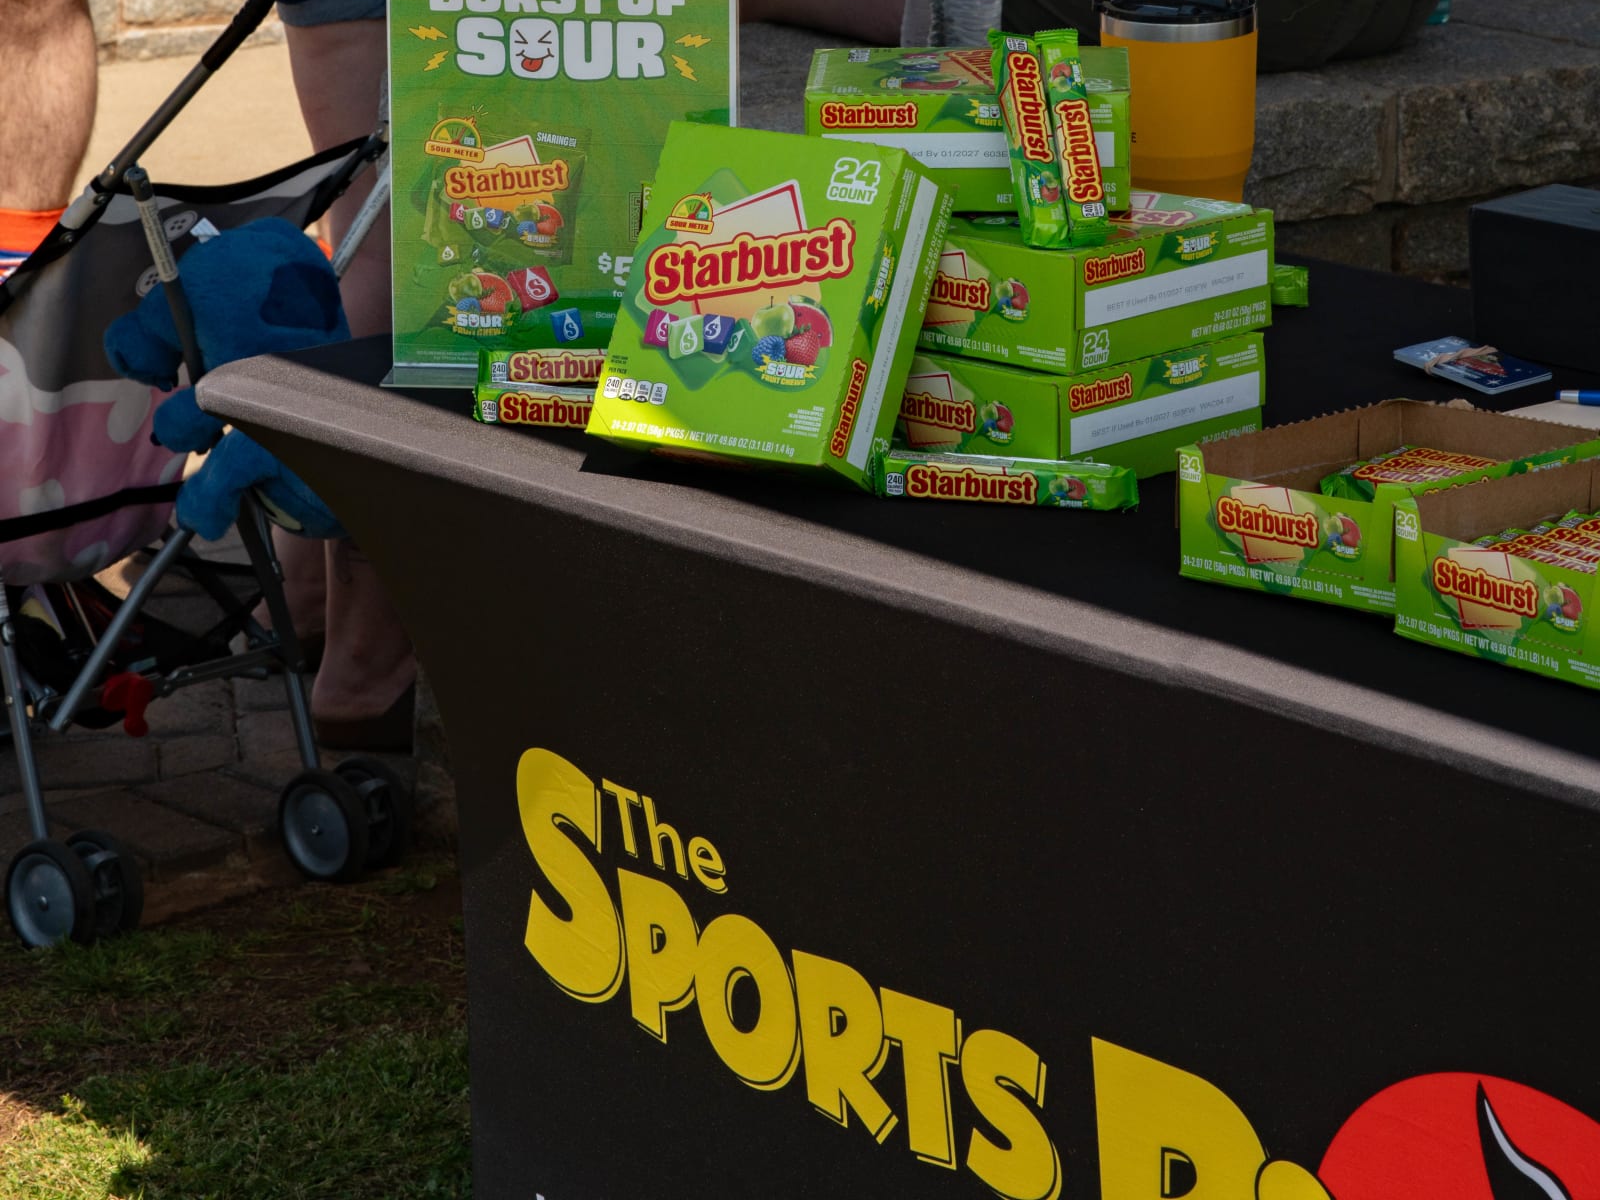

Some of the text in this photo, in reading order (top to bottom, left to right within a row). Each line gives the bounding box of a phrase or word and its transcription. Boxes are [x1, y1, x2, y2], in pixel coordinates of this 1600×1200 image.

[456, 16, 665, 79] SOUR
[823, 103, 915, 127] Starburst
[978, 104, 1001, 119] SO
[1012, 55, 1052, 162] Starburst
[536, 131, 570, 146] SHARING
[1062, 101, 1101, 201] Starburst
[926, 150, 938, 159] By
[983, 150, 1009, 159] 603E
[449, 163, 564, 195] Starburst
[832, 158, 880, 188] 24
[829, 184, 878, 204] COUNT
[1181, 233, 1212, 253] SOUR
[650, 226, 847, 295] Starburst
[1086, 249, 1145, 283] Starburst
[871, 256, 892, 300] SOUR
[930, 274, 988, 307] rburst
[456, 314, 502, 328] SOUR
[922, 330, 936, 342] NET
[935, 332, 947, 344] WT
[1083, 329, 1110, 354] 24
[491, 363, 507, 374] 240
[513, 355, 605, 381] Starbur
[766, 361, 806, 380] SOUR
[1083, 351, 1109, 368] COUNT
[1168, 357, 1201, 378] SOUR
[606, 377, 620, 389] 240
[761, 373, 781, 385] FRUIT
[1070, 374, 1131, 411] Starburst
[482, 401, 496, 413] 240
[503, 396, 594, 426] Starbur
[831, 361, 868, 457] Starburst
[904, 395, 974, 428] arburst
[636, 422, 647, 434] OZ
[664, 427, 685, 440] PKGS
[688, 430, 705, 442] NET
[704, 433, 719, 444] WT
[718, 435, 738, 447] 49.68
[737, 438, 748, 449] OZ
[747, 439, 761, 451] (3.1
[760, 442, 774, 453] LB)
[784, 445, 795, 457] kg
[1180, 455, 1201, 473] 24
[1407, 448, 1498, 467] Starbur
[887, 473, 904, 485] 240
[910, 469, 1036, 502] Starburst
[1180, 470, 1201, 483] COUNT
[1219, 499, 1318, 547] Starburst
[1395, 510, 1418, 532] 24
[1182, 554, 1204, 568] 24-2.07
[1202, 559, 1213, 570] OZ
[1227, 563, 1246, 577] PKGS
[1248, 567, 1264, 581] NET
[1262, 570, 1276, 583] WT
[1291, 576, 1301, 588] OZ
[1300, 578, 1313, 591] (3.1
[1333, 585, 1343, 598] kg
[1436, 559, 1536, 612] Starburst
[1396, 614, 1419, 629] 24-2.07
[1417, 620, 1428, 632] OZ
[1441, 627, 1461, 642] PKGS
[1463, 633, 1478, 647] NET
[1475, 636, 1490, 650] WT
[1506, 645, 1518, 658] OZ
[1516, 648, 1529, 661] (3.1
[1548, 658, 1560, 672] kg
[596, 778, 728, 894] The
[517, 747, 1064, 1200] SPORTS
